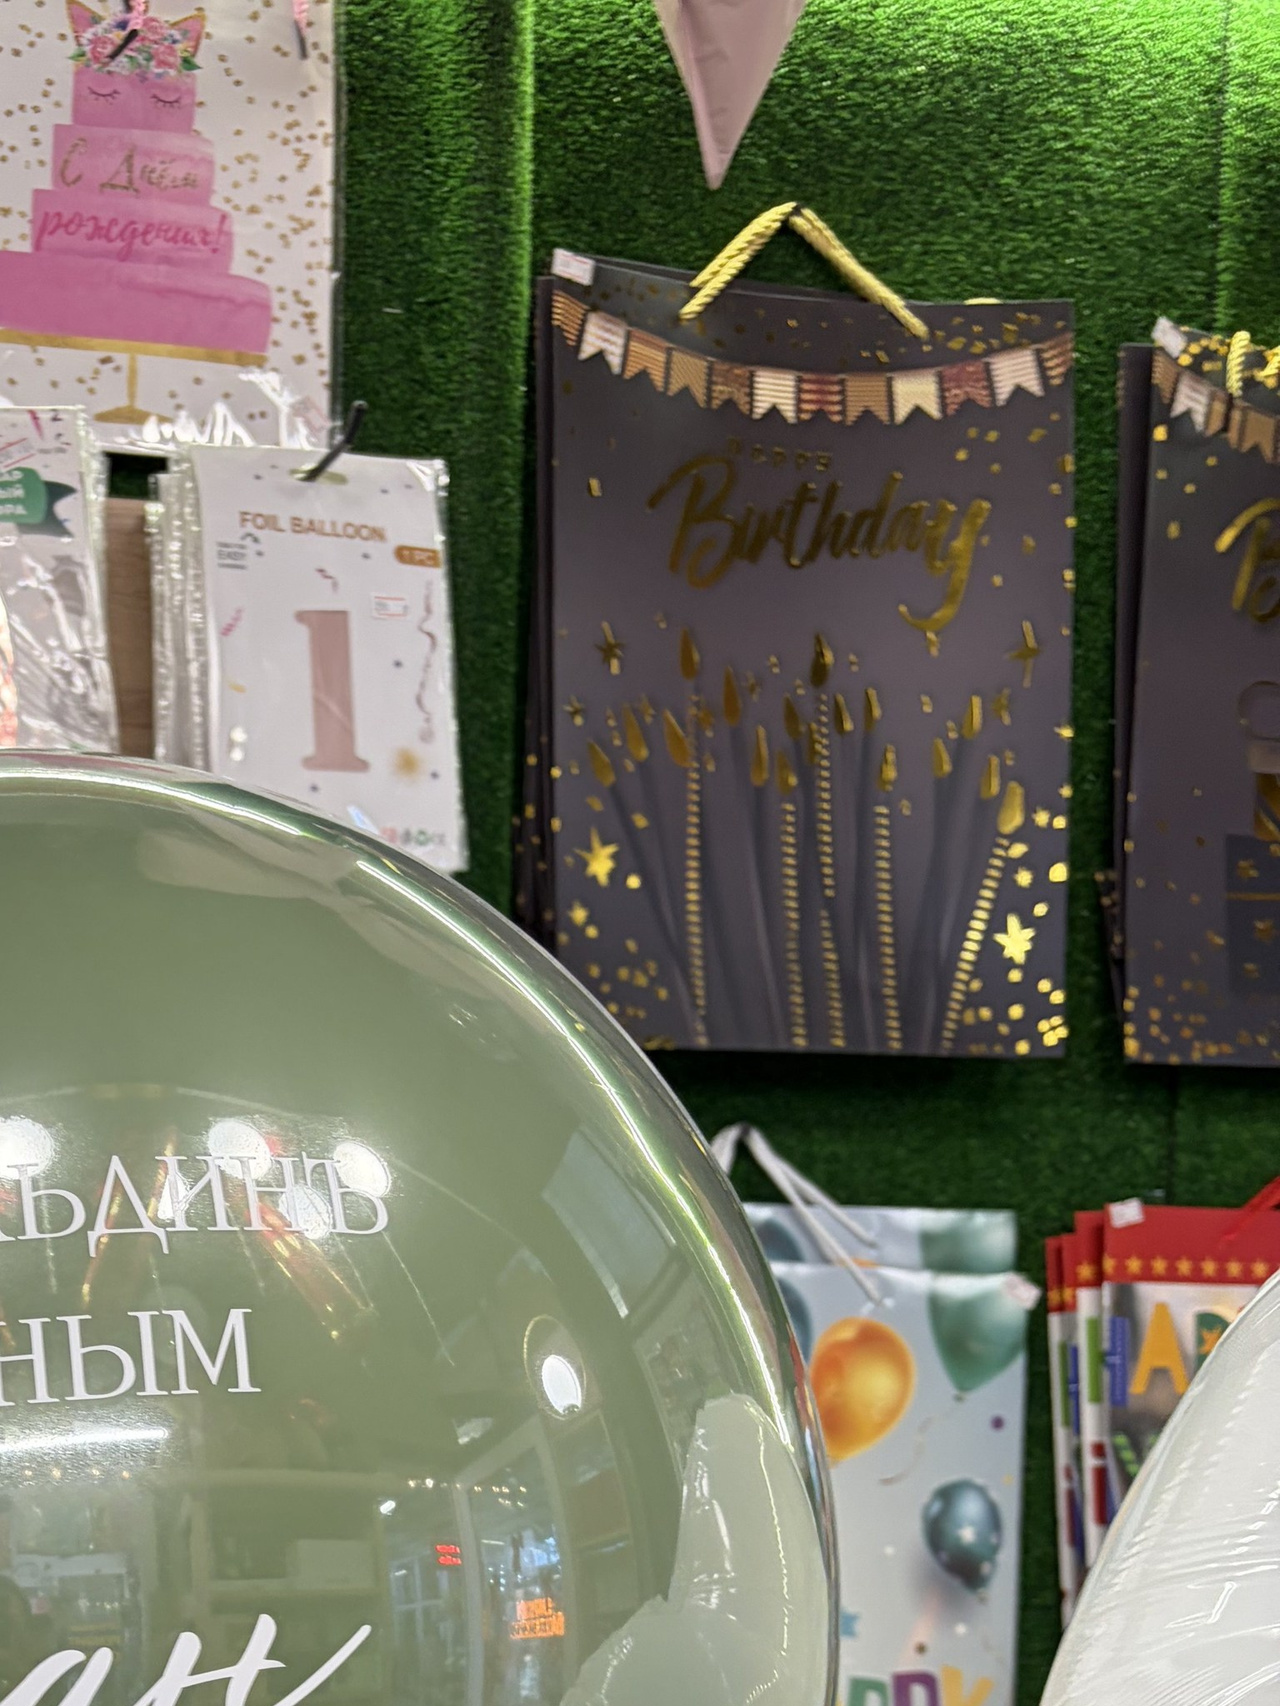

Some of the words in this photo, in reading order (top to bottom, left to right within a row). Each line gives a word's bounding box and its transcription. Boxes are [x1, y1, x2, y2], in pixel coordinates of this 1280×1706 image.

[34, 210, 228, 262] рождения!
[239, 512, 286, 532] FOIL
[289, 516, 387, 542] BALLOON
[647, 453, 991, 632] Birthday
